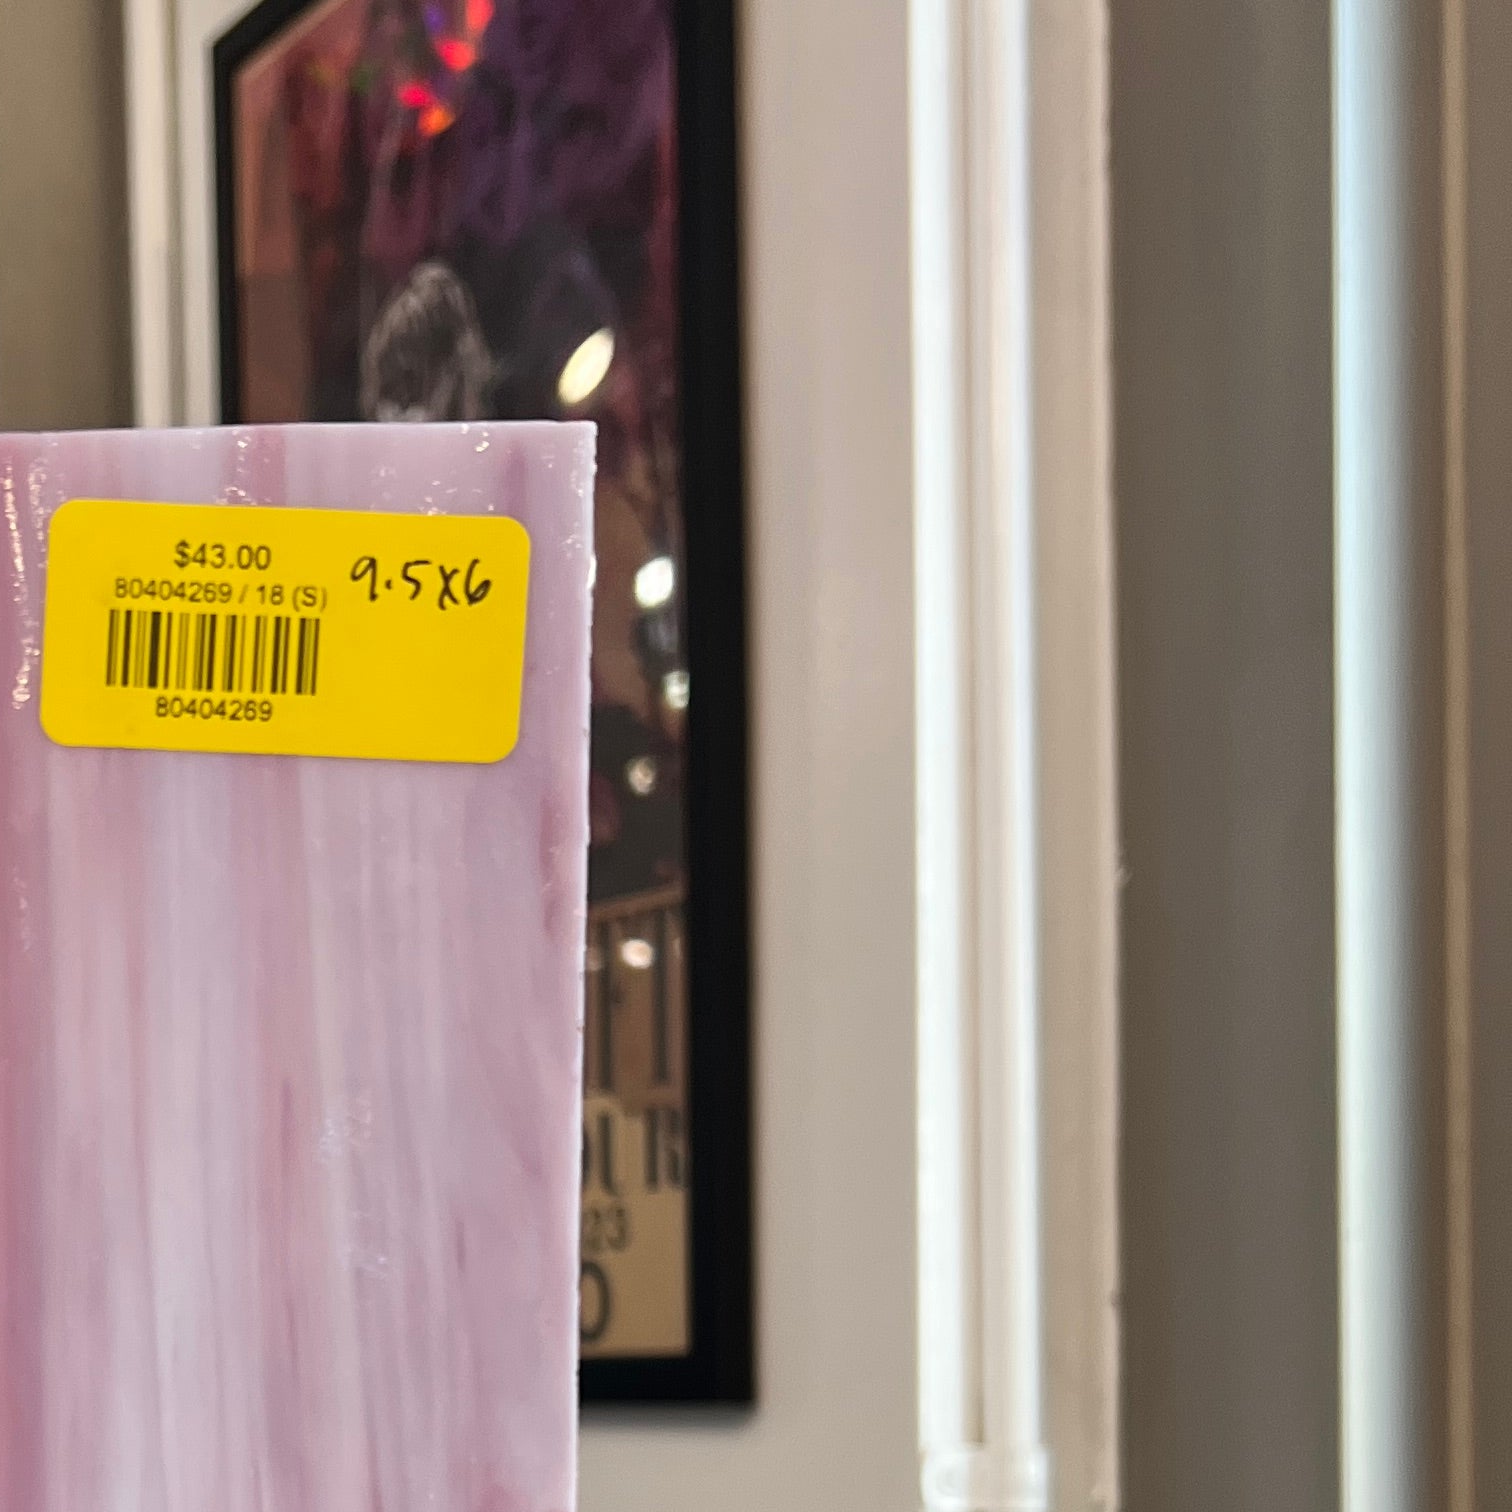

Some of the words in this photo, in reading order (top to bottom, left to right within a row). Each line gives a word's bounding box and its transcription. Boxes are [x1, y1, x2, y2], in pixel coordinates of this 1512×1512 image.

[173, 539, 272, 571] $43.00
[114, 577, 233, 604] 80404269
[256, 585, 285, 606] 18
[292, 585, 328, 612] (S)
[155, 696, 273, 722] 80404269
